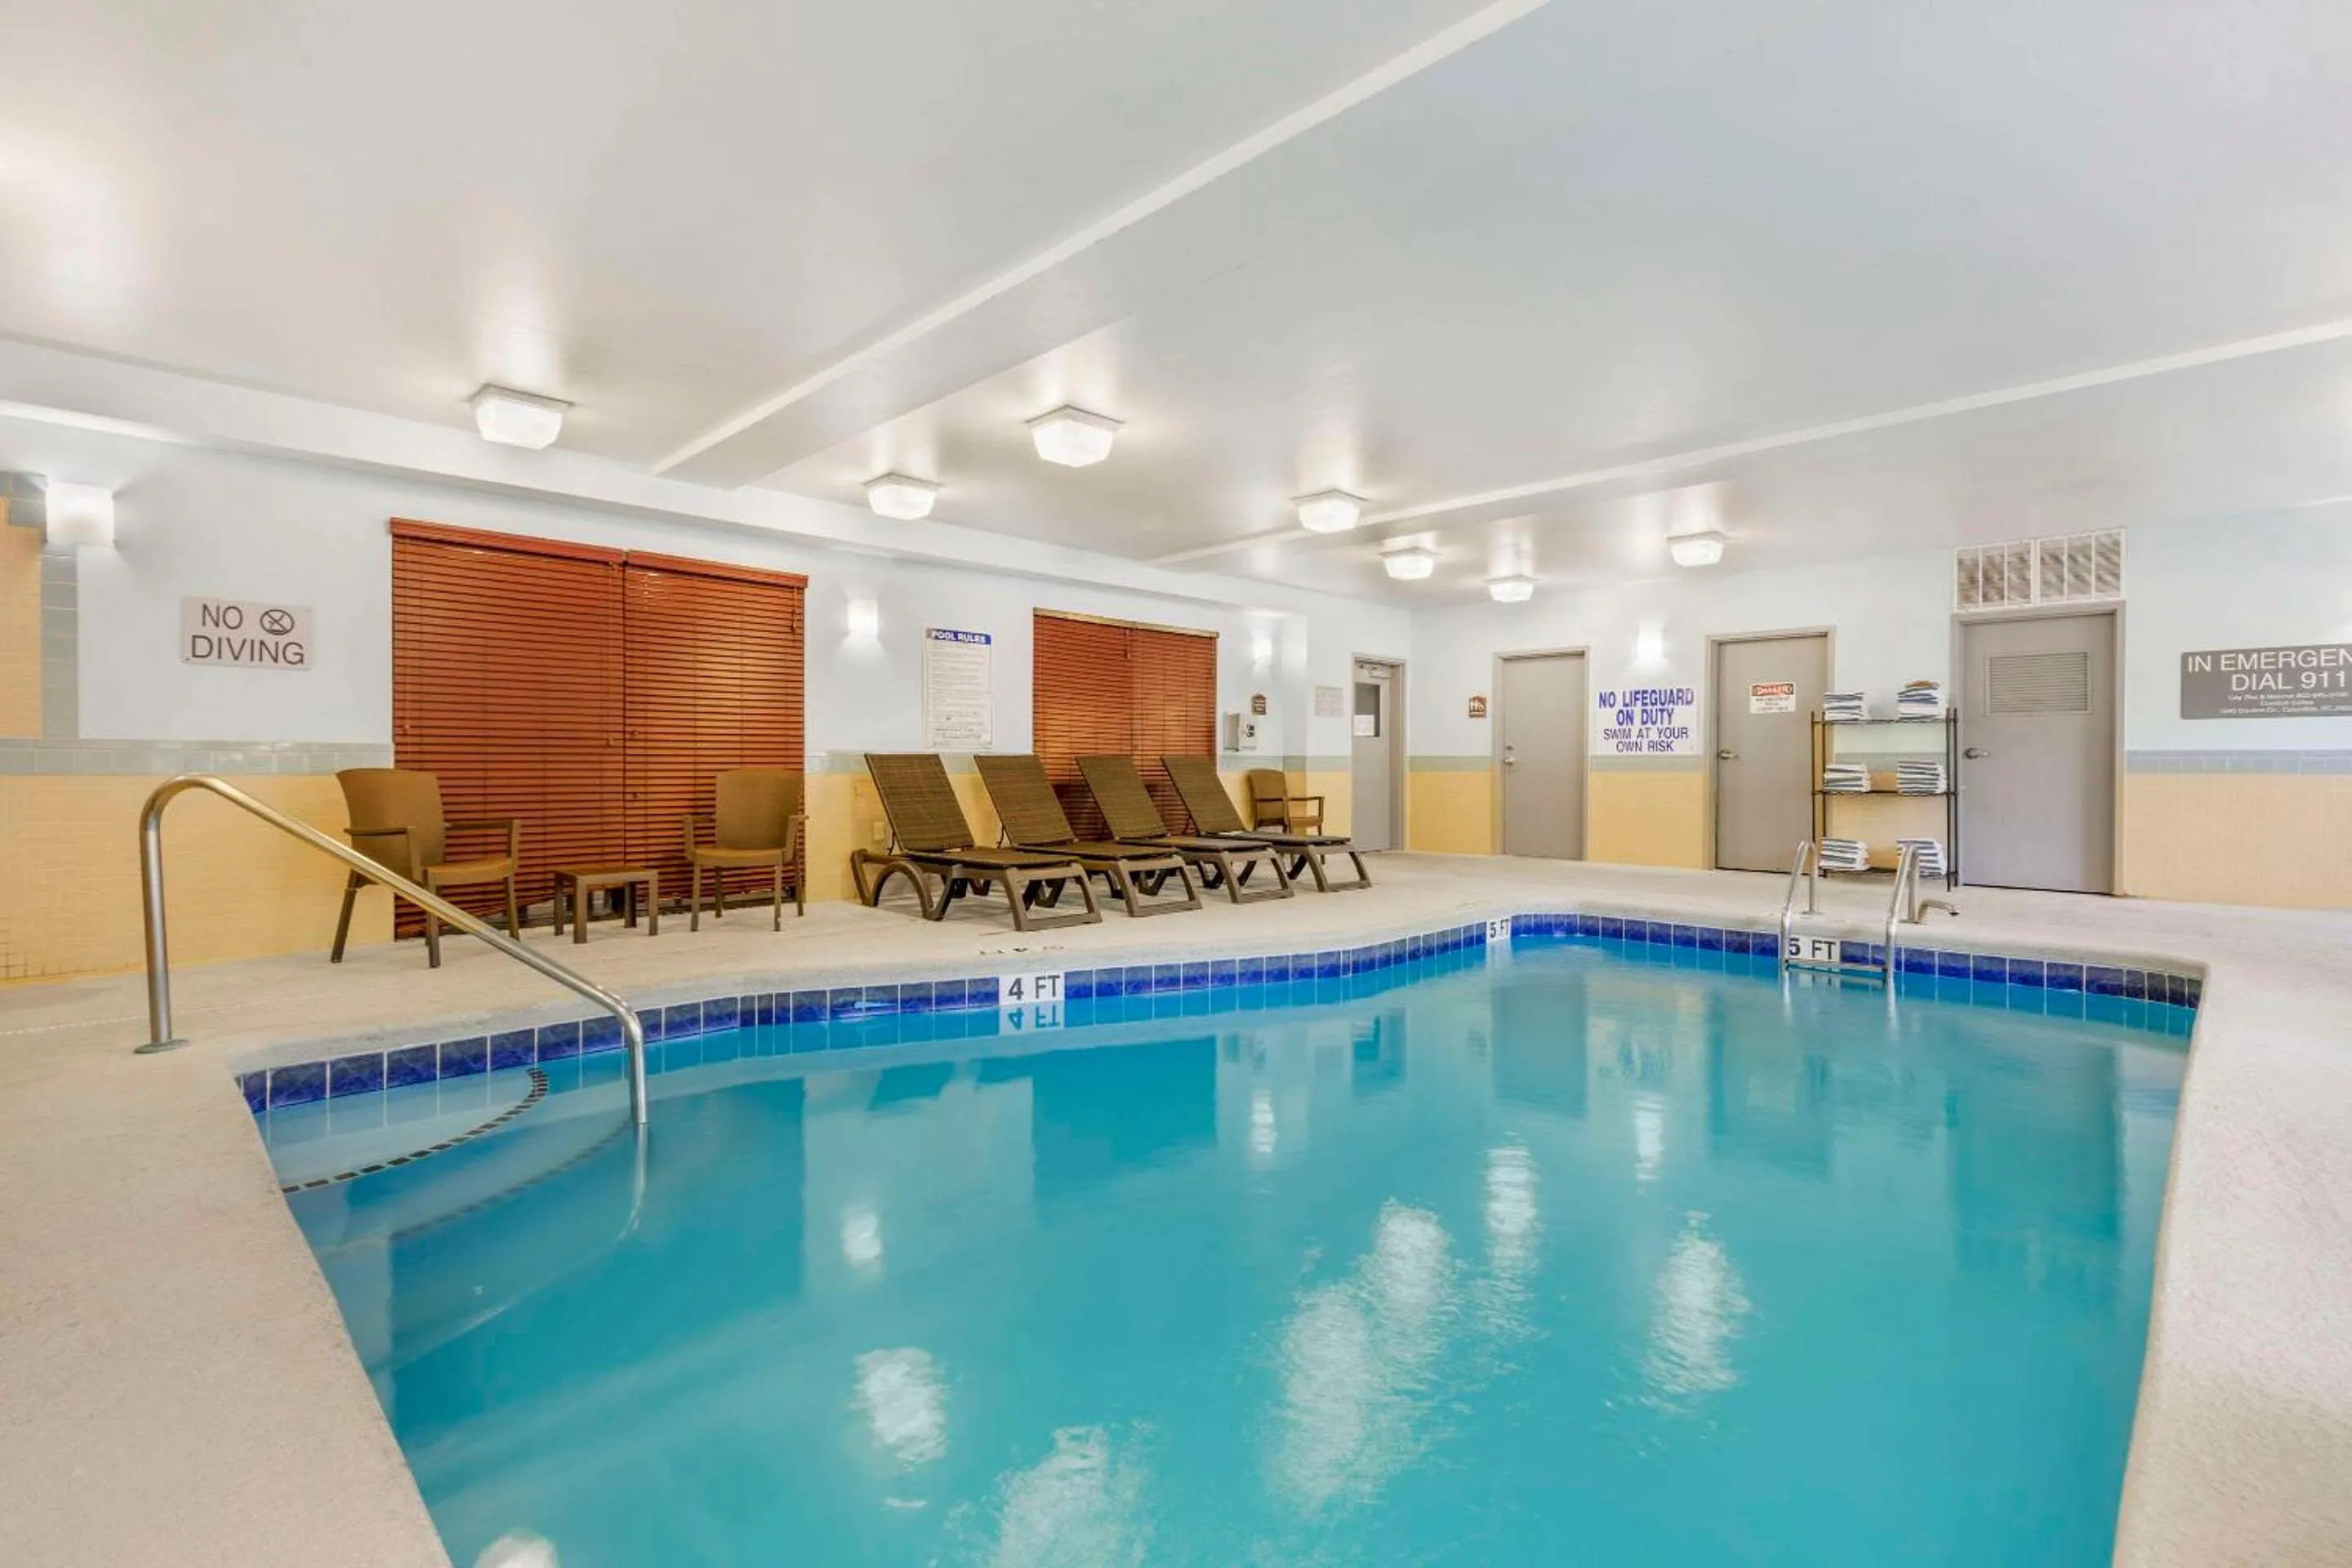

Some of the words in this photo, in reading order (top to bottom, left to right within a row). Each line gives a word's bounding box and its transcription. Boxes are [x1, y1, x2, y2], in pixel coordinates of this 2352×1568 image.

[202, 603, 243, 630] NO
[931, 630, 957, 640] POOL
[957, 632, 986, 644] RULES
[191, 635, 305, 666] DIVING
[2188, 655, 2212, 673] IN
[2231, 672, 2293, 691] DIAL
[2301, 670, 2345, 689] 911
[1598, 691, 1616, 709] NO
[1622, 688, 1695, 707] LIFEGUARD
[1616, 709, 1634, 726] ON
[1641, 708, 1674, 725] DUTY
[1603, 728, 1632, 741] SWIM
[1637, 727, 1650, 739] AT
[1657, 727, 1688, 739] YOUR
[1616, 741, 1642, 752] OWN
[1647, 740, 1674, 751] RISK
[1490, 922, 1496, 938] 5
[1500, 919, 1509, 937] FT
[1789, 938, 1801, 956] 5
[1812, 939, 1836, 960] FT
[1008, 978, 1024, 1000] 4
[1035, 974, 1061, 999] FT
